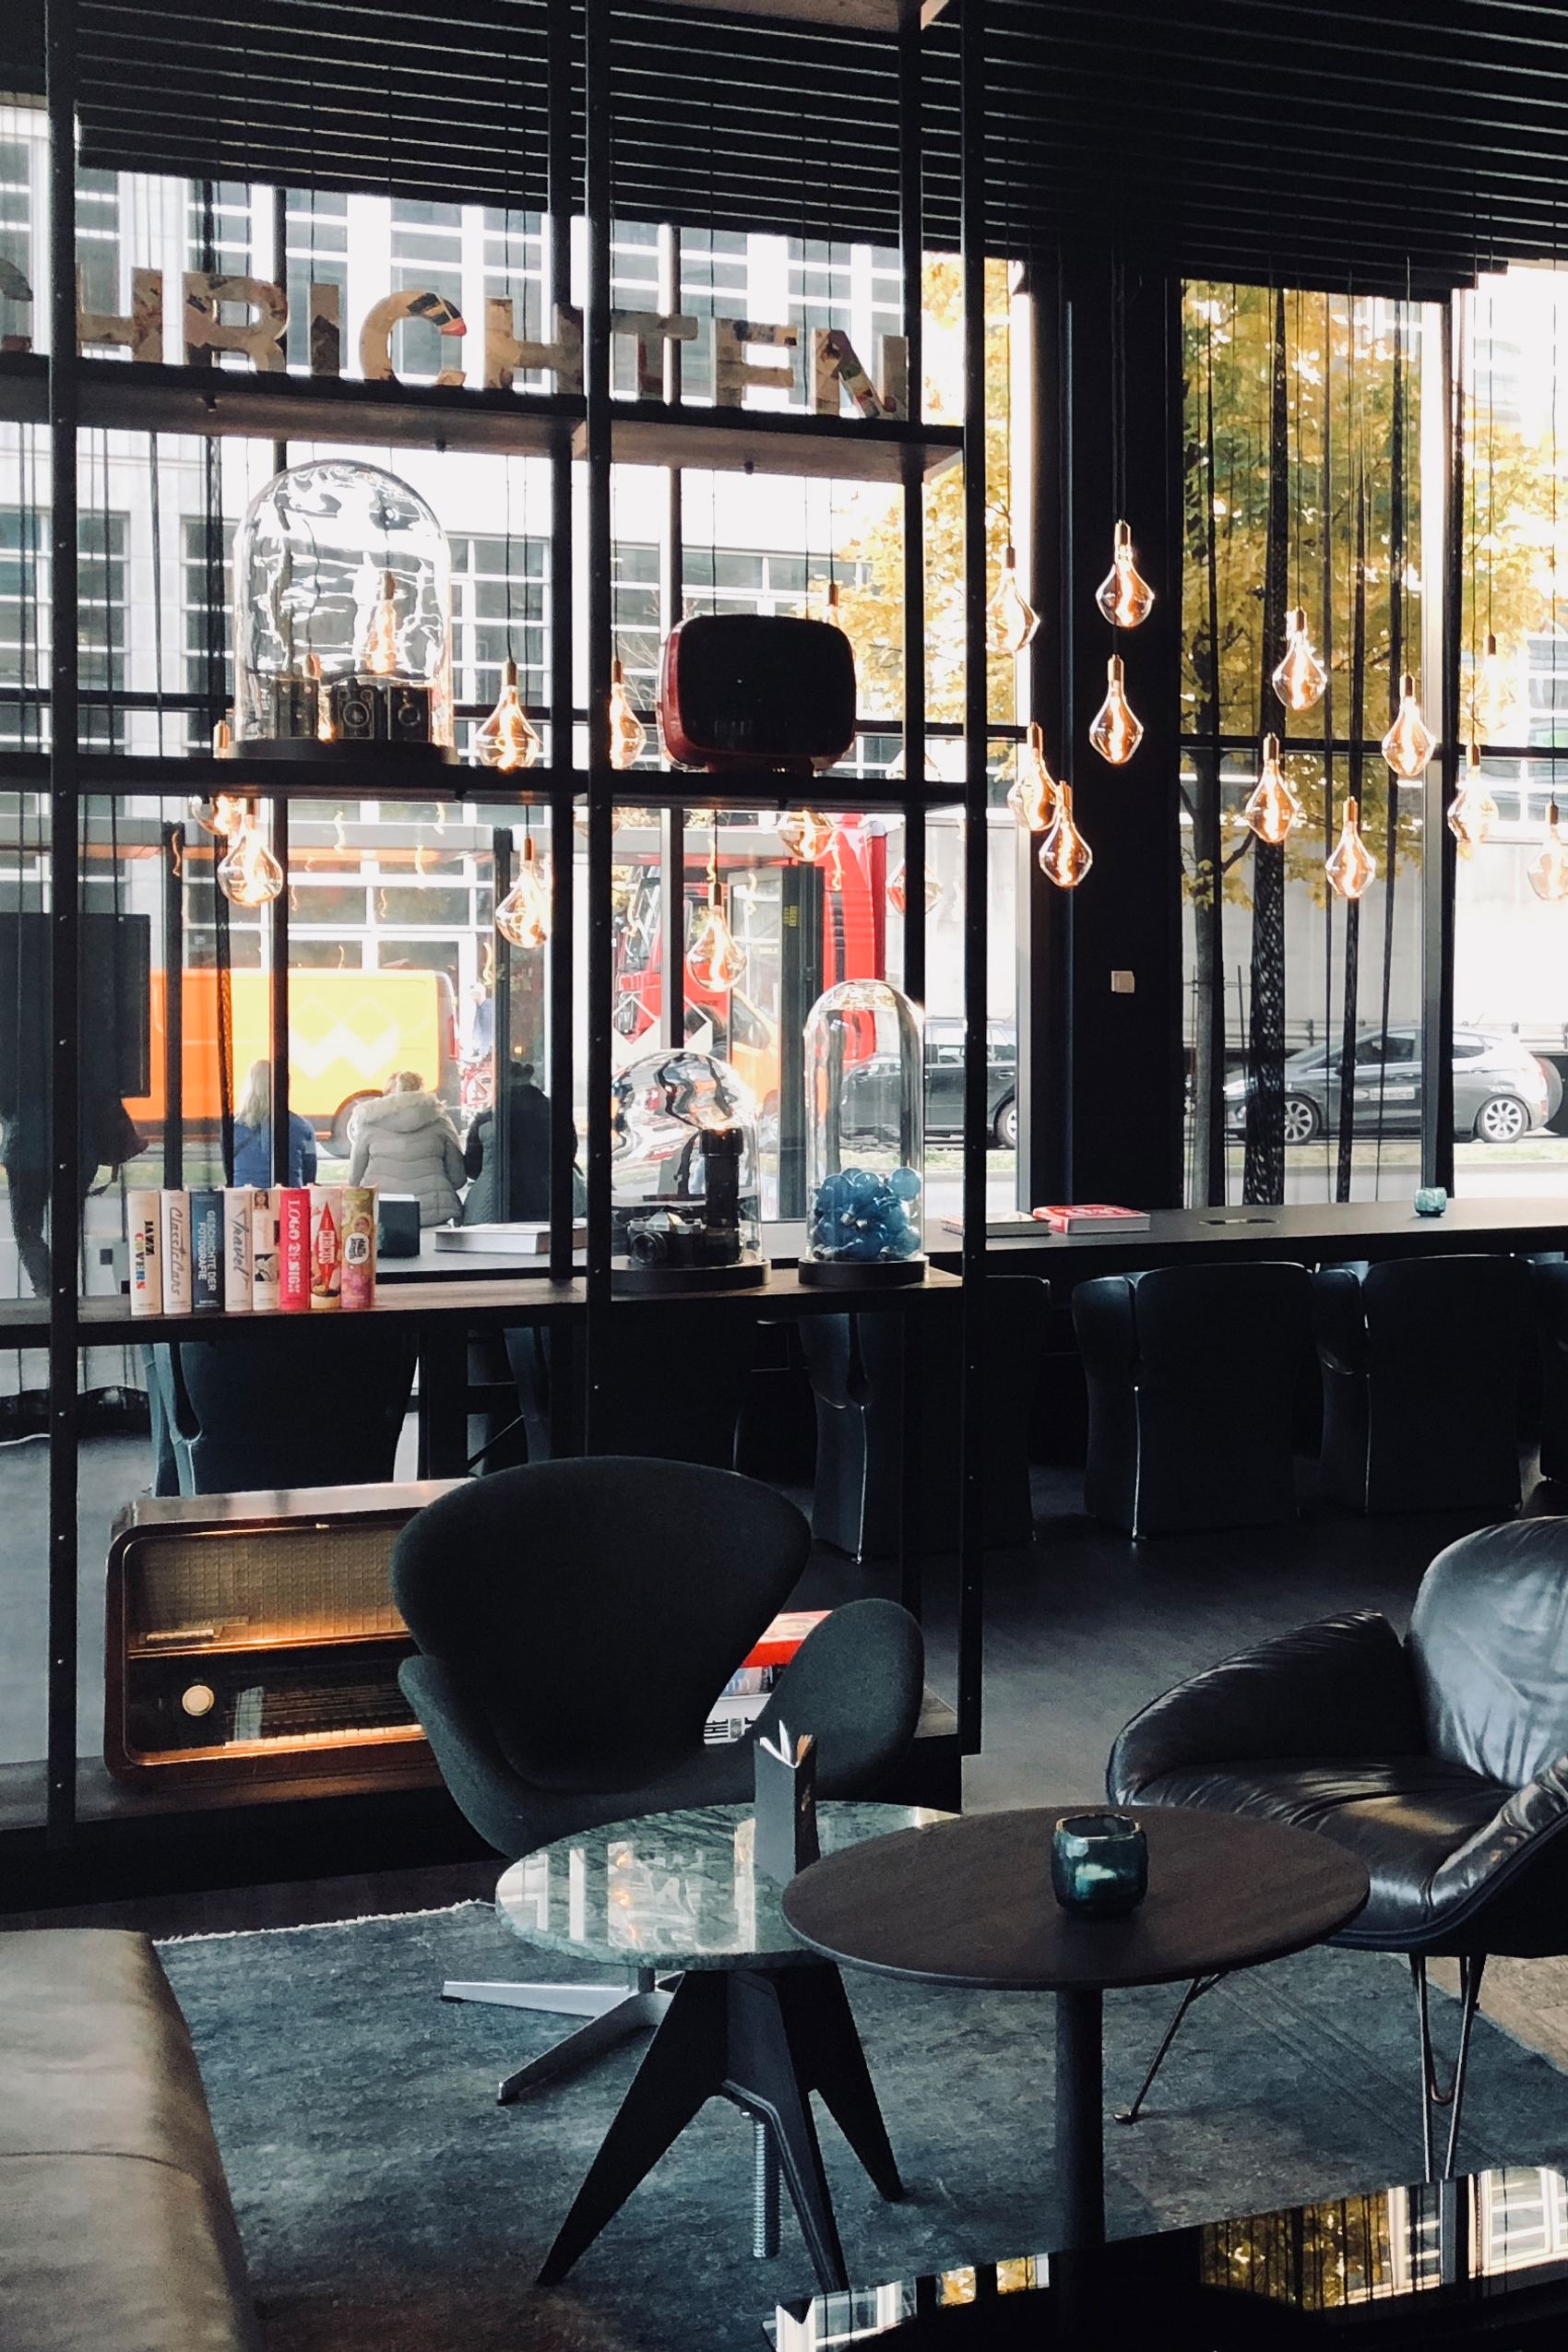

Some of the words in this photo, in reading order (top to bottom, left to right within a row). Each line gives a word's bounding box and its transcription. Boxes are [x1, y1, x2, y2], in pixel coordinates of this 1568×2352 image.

[145, 1220, 155, 1255] JAZZ
[207, 1209, 217, 1271] GESCHICHTE
[288, 1200, 301, 1241] LOGO
[135, 1232, 146, 1289] COVERS
[197, 1222, 208, 1280] FOTOGRAFIE
[230, 1207, 250, 1289] Travel
[318, 1229, 335, 1265] CIRCUS
[208, 1272, 217, 1291] DER
